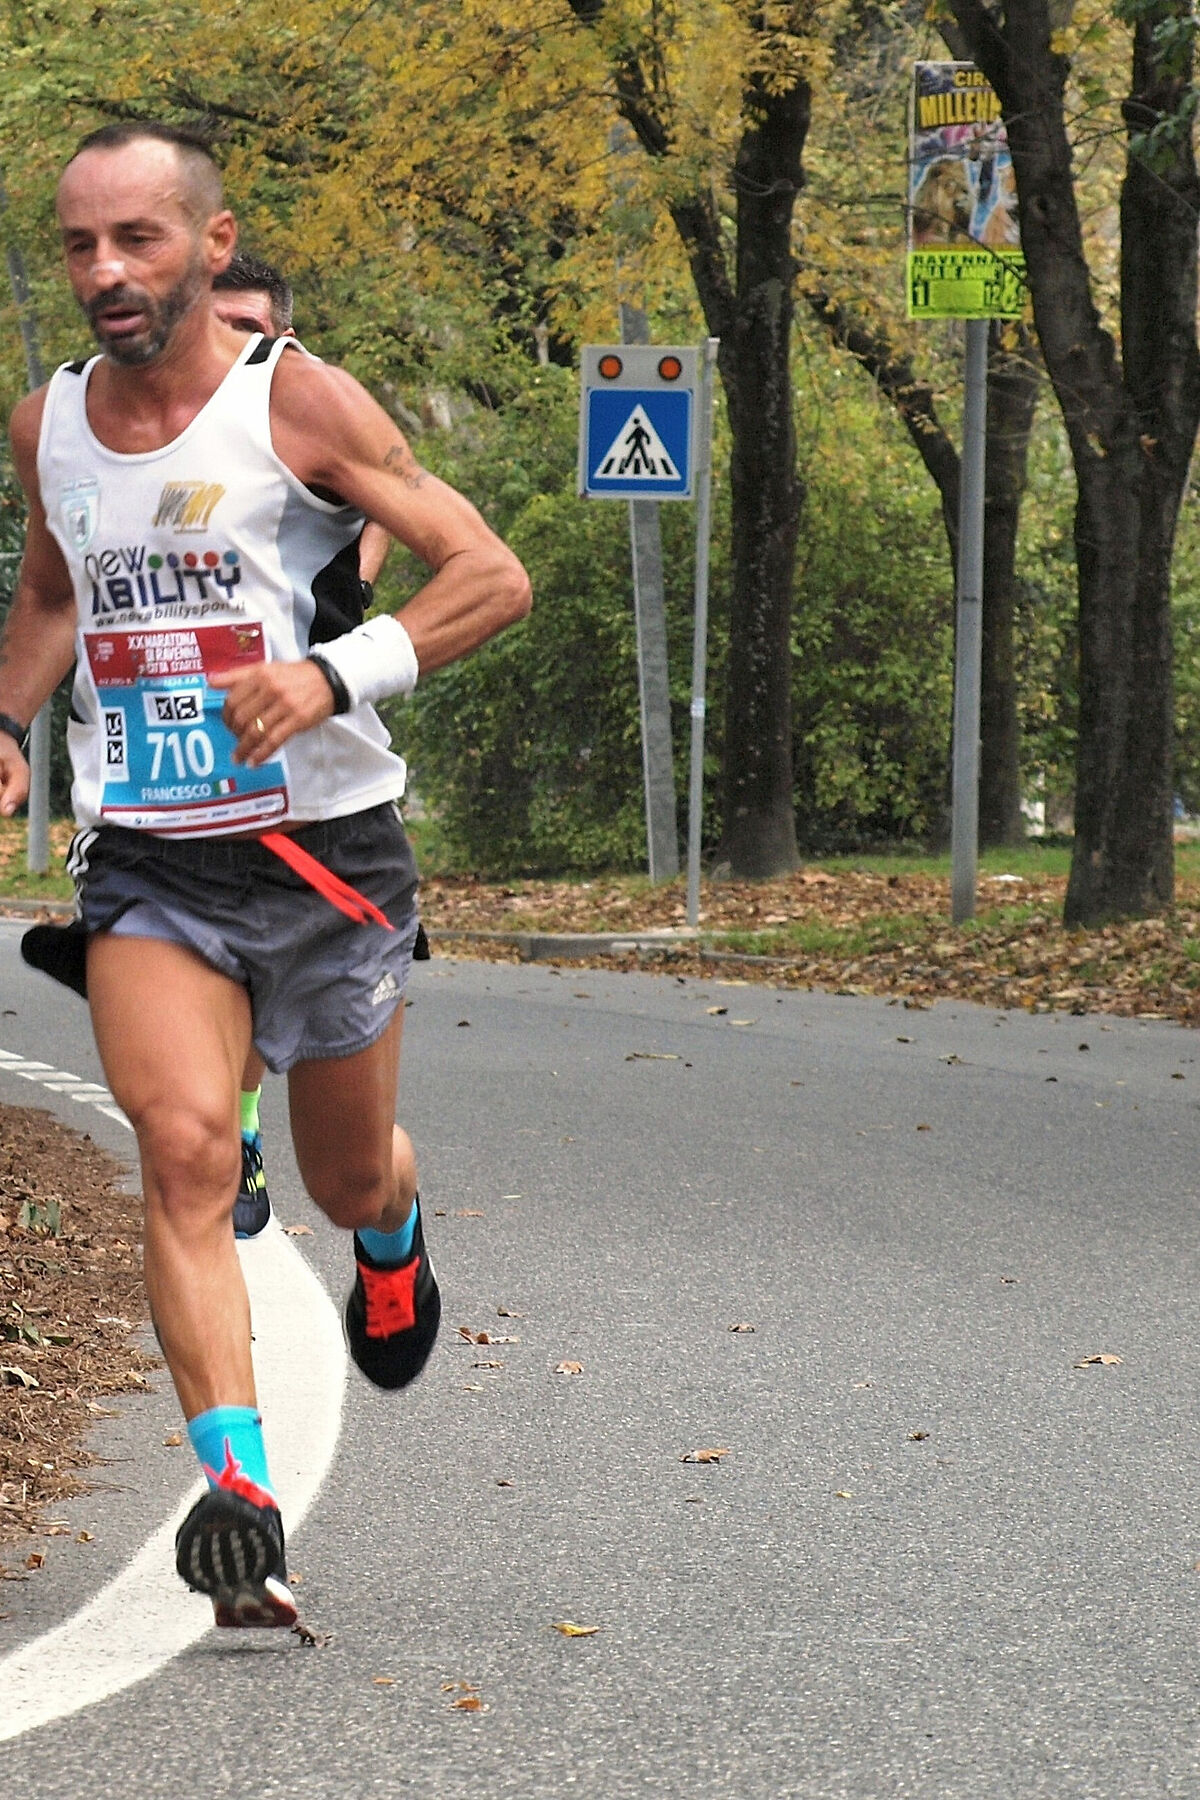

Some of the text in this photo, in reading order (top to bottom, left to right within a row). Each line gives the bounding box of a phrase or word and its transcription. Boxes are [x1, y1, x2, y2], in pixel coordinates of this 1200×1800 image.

[954, 70, 991, 88] CIR
[85, 546, 146, 580] new
[91, 566, 242, 615] ABILITY
[145, 631, 198, 649] MARATONA
[156, 645, 202, 661] RAVENNA
[146, 729, 215, 782] 710
[141, 782, 212, 801] FRANCESCO
